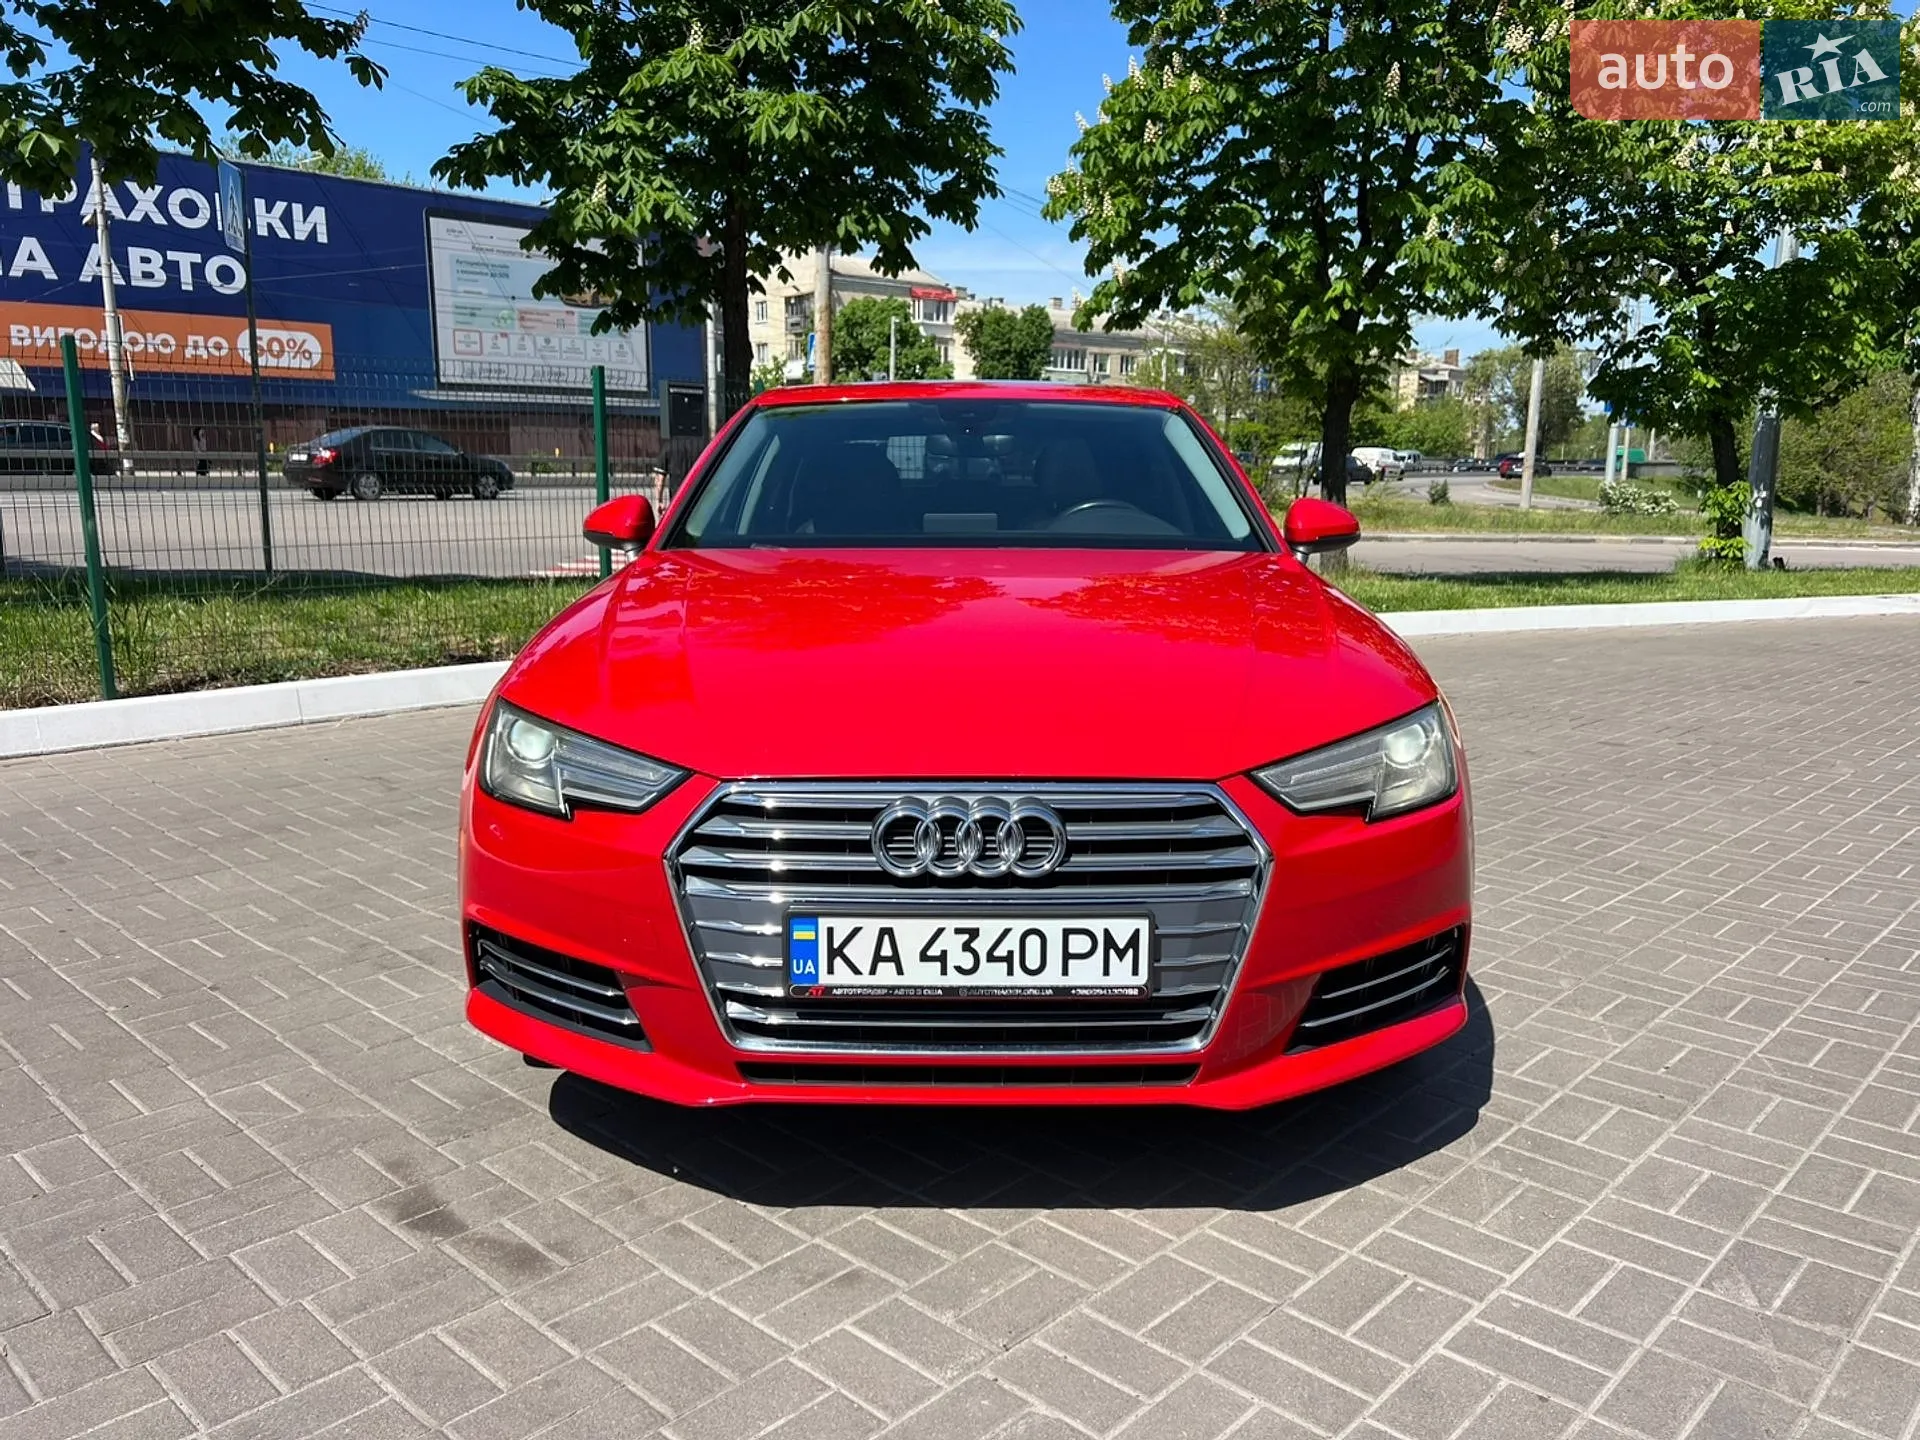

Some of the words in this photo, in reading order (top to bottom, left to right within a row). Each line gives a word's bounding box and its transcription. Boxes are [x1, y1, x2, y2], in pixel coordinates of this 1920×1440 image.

[6, 178, 329, 244] РАХОКИ
[0, 236, 59, 281] А
[79, 243, 247, 296] АВТО
[184, 334, 229, 359] ДО
[793, 959, 816, 975] UA
[826, 926, 904, 976] KA
[919, 926, 1047, 977] 4340
[1061, 927, 1141, 977] PM
